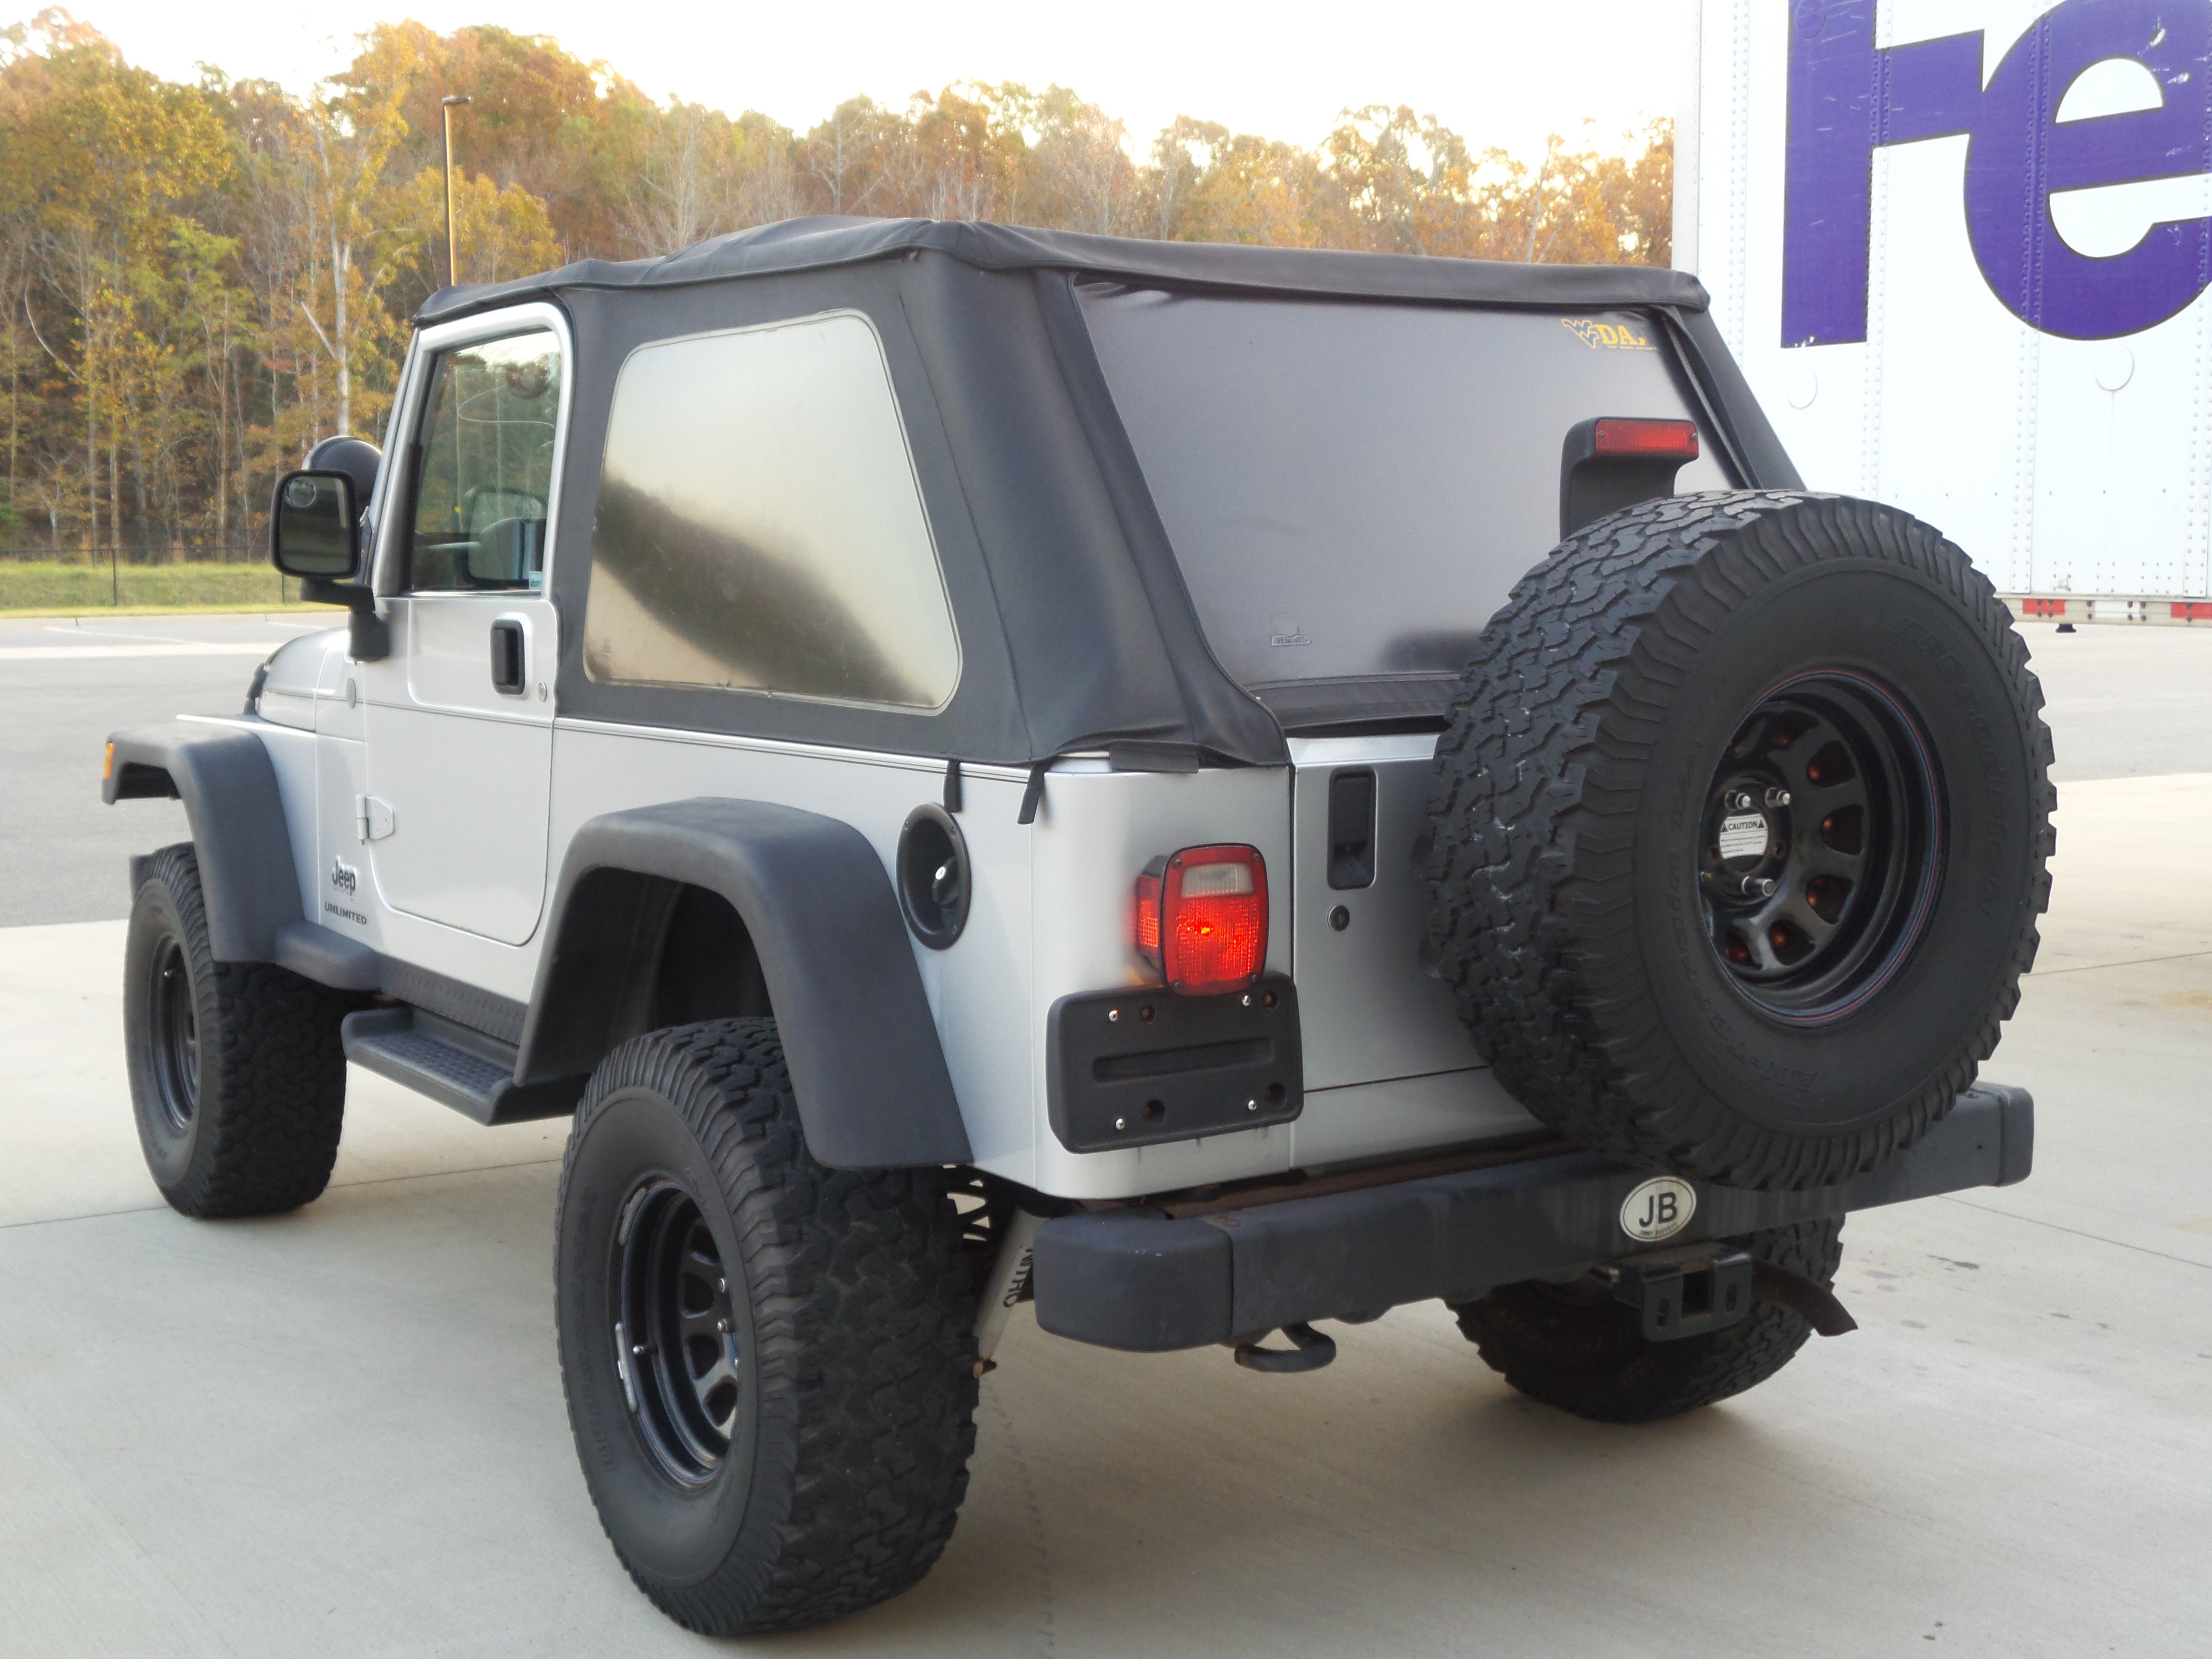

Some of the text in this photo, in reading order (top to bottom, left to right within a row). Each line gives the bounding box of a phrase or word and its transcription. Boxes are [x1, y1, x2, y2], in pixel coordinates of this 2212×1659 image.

[1729, 821, 1757, 830] CAUTION
[332, 859, 356, 896] Jeep
[325, 902, 367, 925] UNLIMITED
[1639, 1192, 1677, 1227] JB
